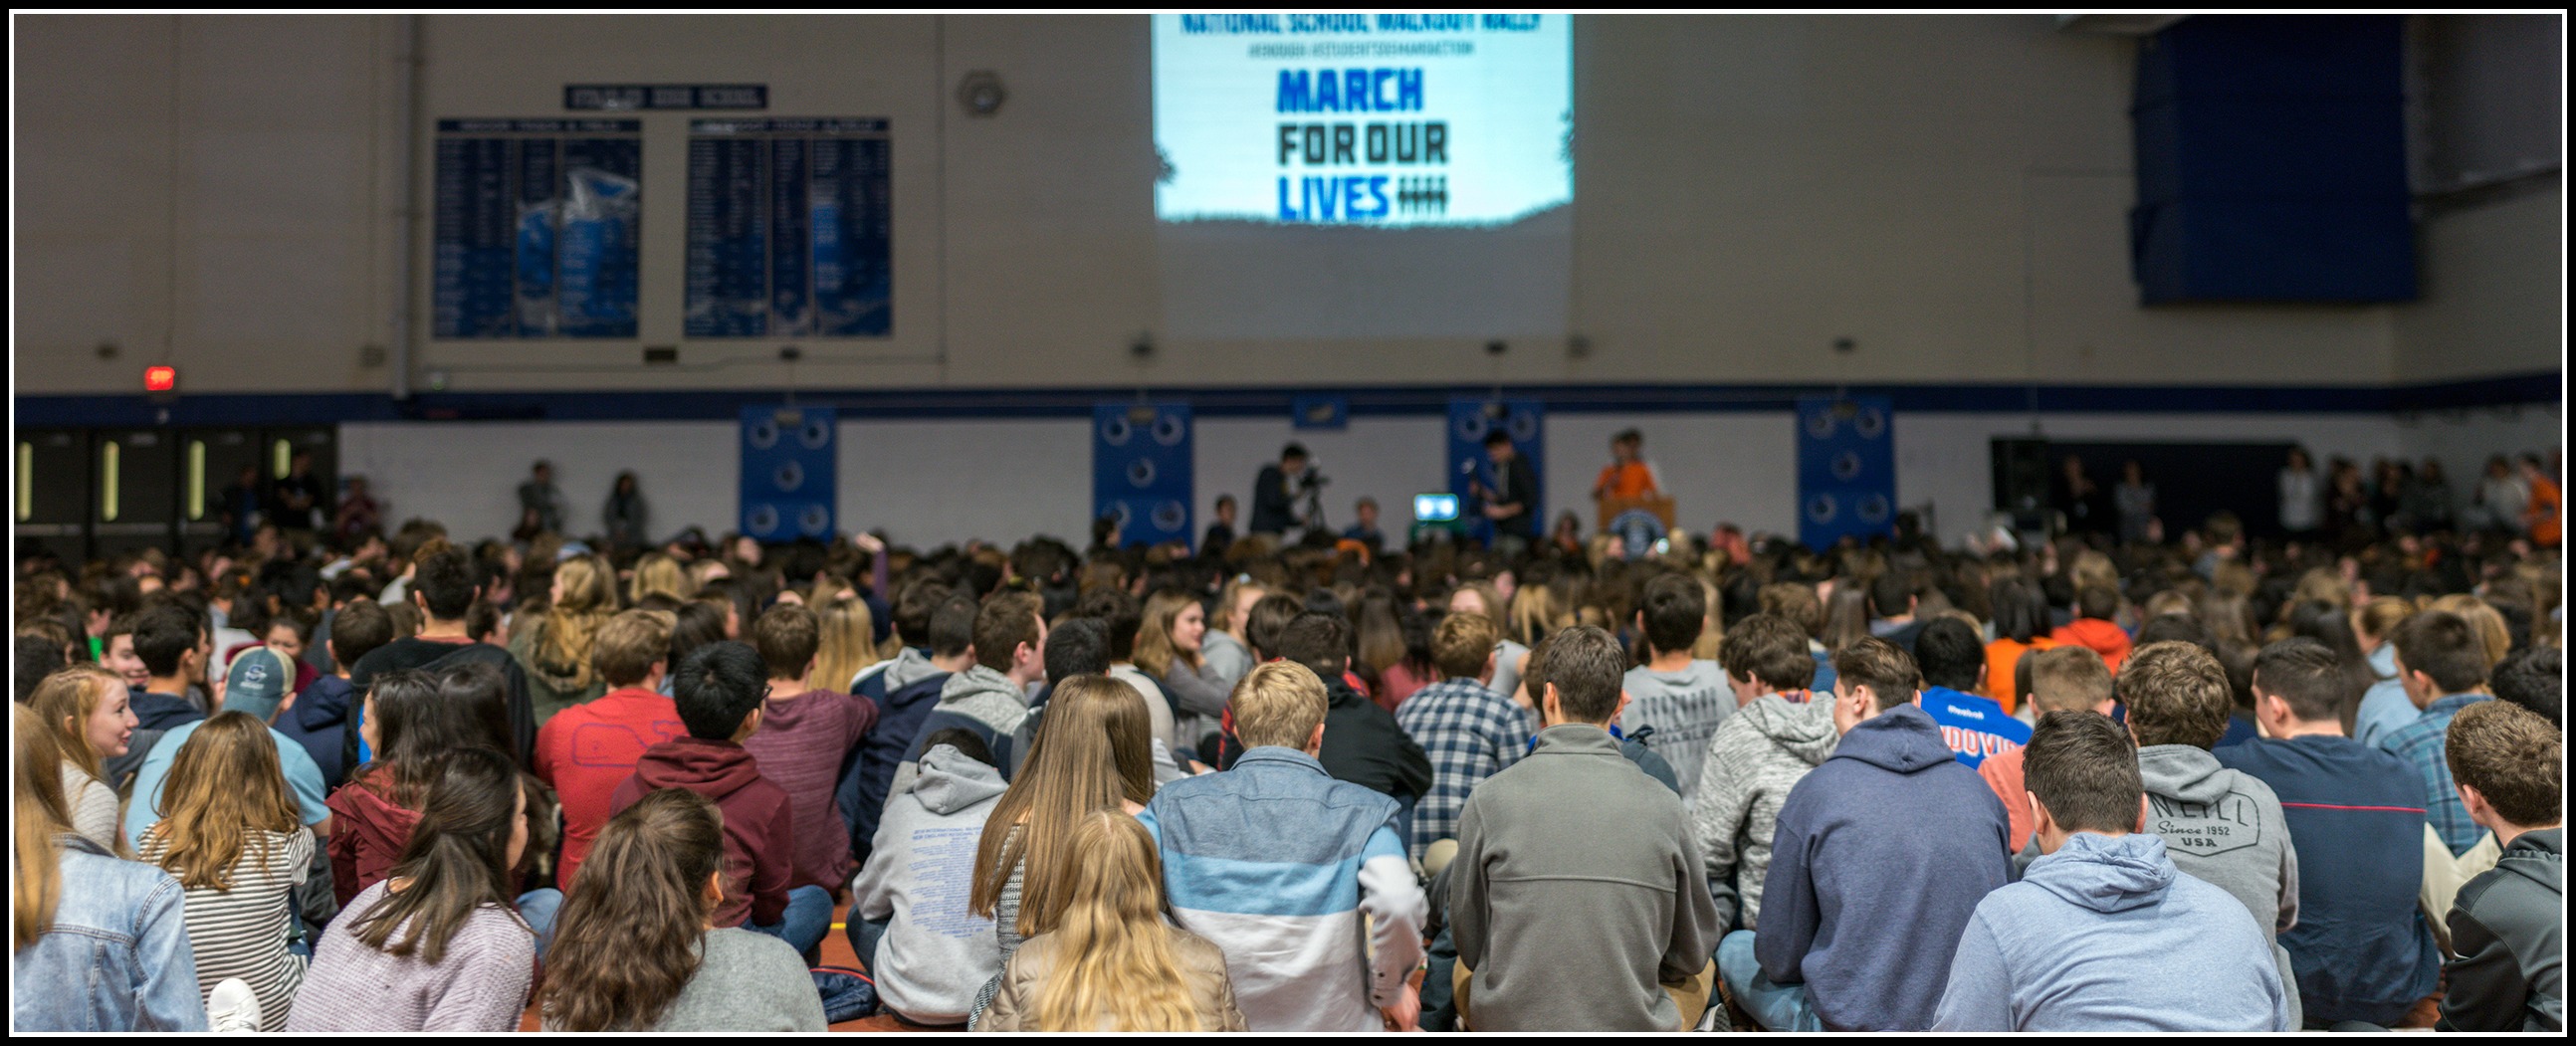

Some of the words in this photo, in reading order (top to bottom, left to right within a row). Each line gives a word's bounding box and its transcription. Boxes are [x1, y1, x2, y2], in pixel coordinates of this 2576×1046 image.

[1277, 68, 1423, 112] MARCH
[1277, 121, 1356, 165] FOR
[1366, 121, 1447, 164] OUR
[1278, 175, 1389, 221] LIVES
[2158, 820, 2202, 835] Since
[2206, 825, 2231, 836] 1952
[2181, 837, 2218, 848] USA
